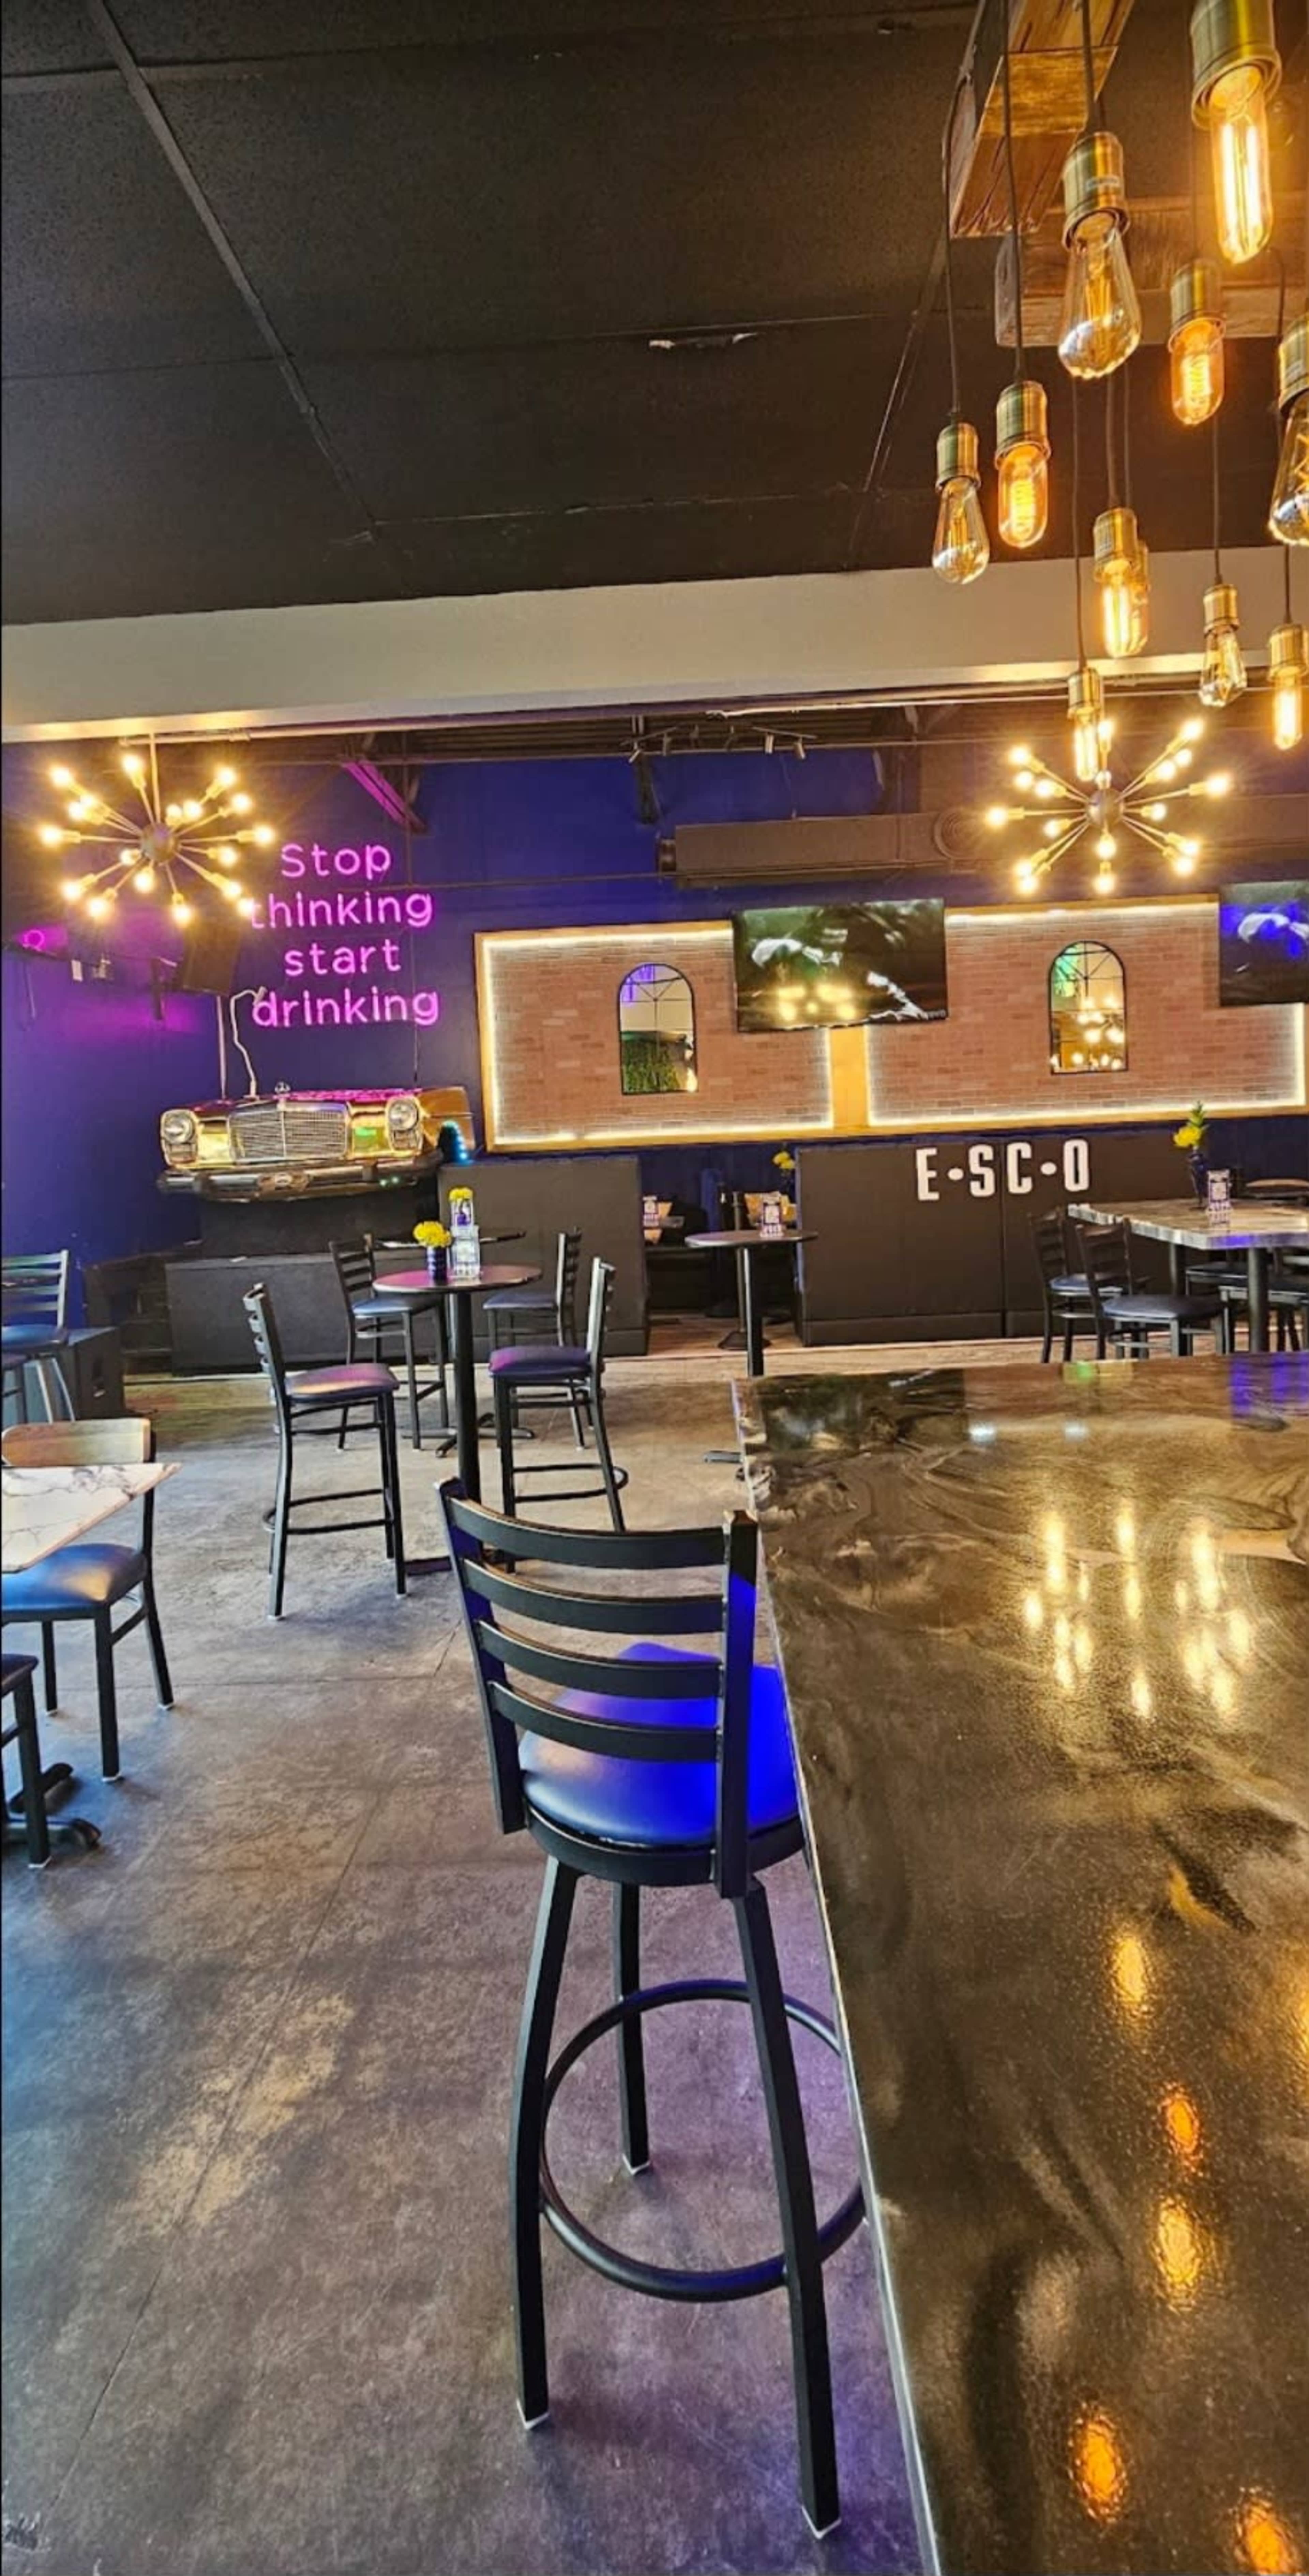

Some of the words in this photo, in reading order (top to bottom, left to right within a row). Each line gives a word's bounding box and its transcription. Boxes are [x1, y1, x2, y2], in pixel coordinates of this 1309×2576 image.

[281, 843, 391, 880] Stop
[250, 891, 432, 928] thinking
[285, 939, 401, 976] start
[252, 986, 439, 1027] drinking
